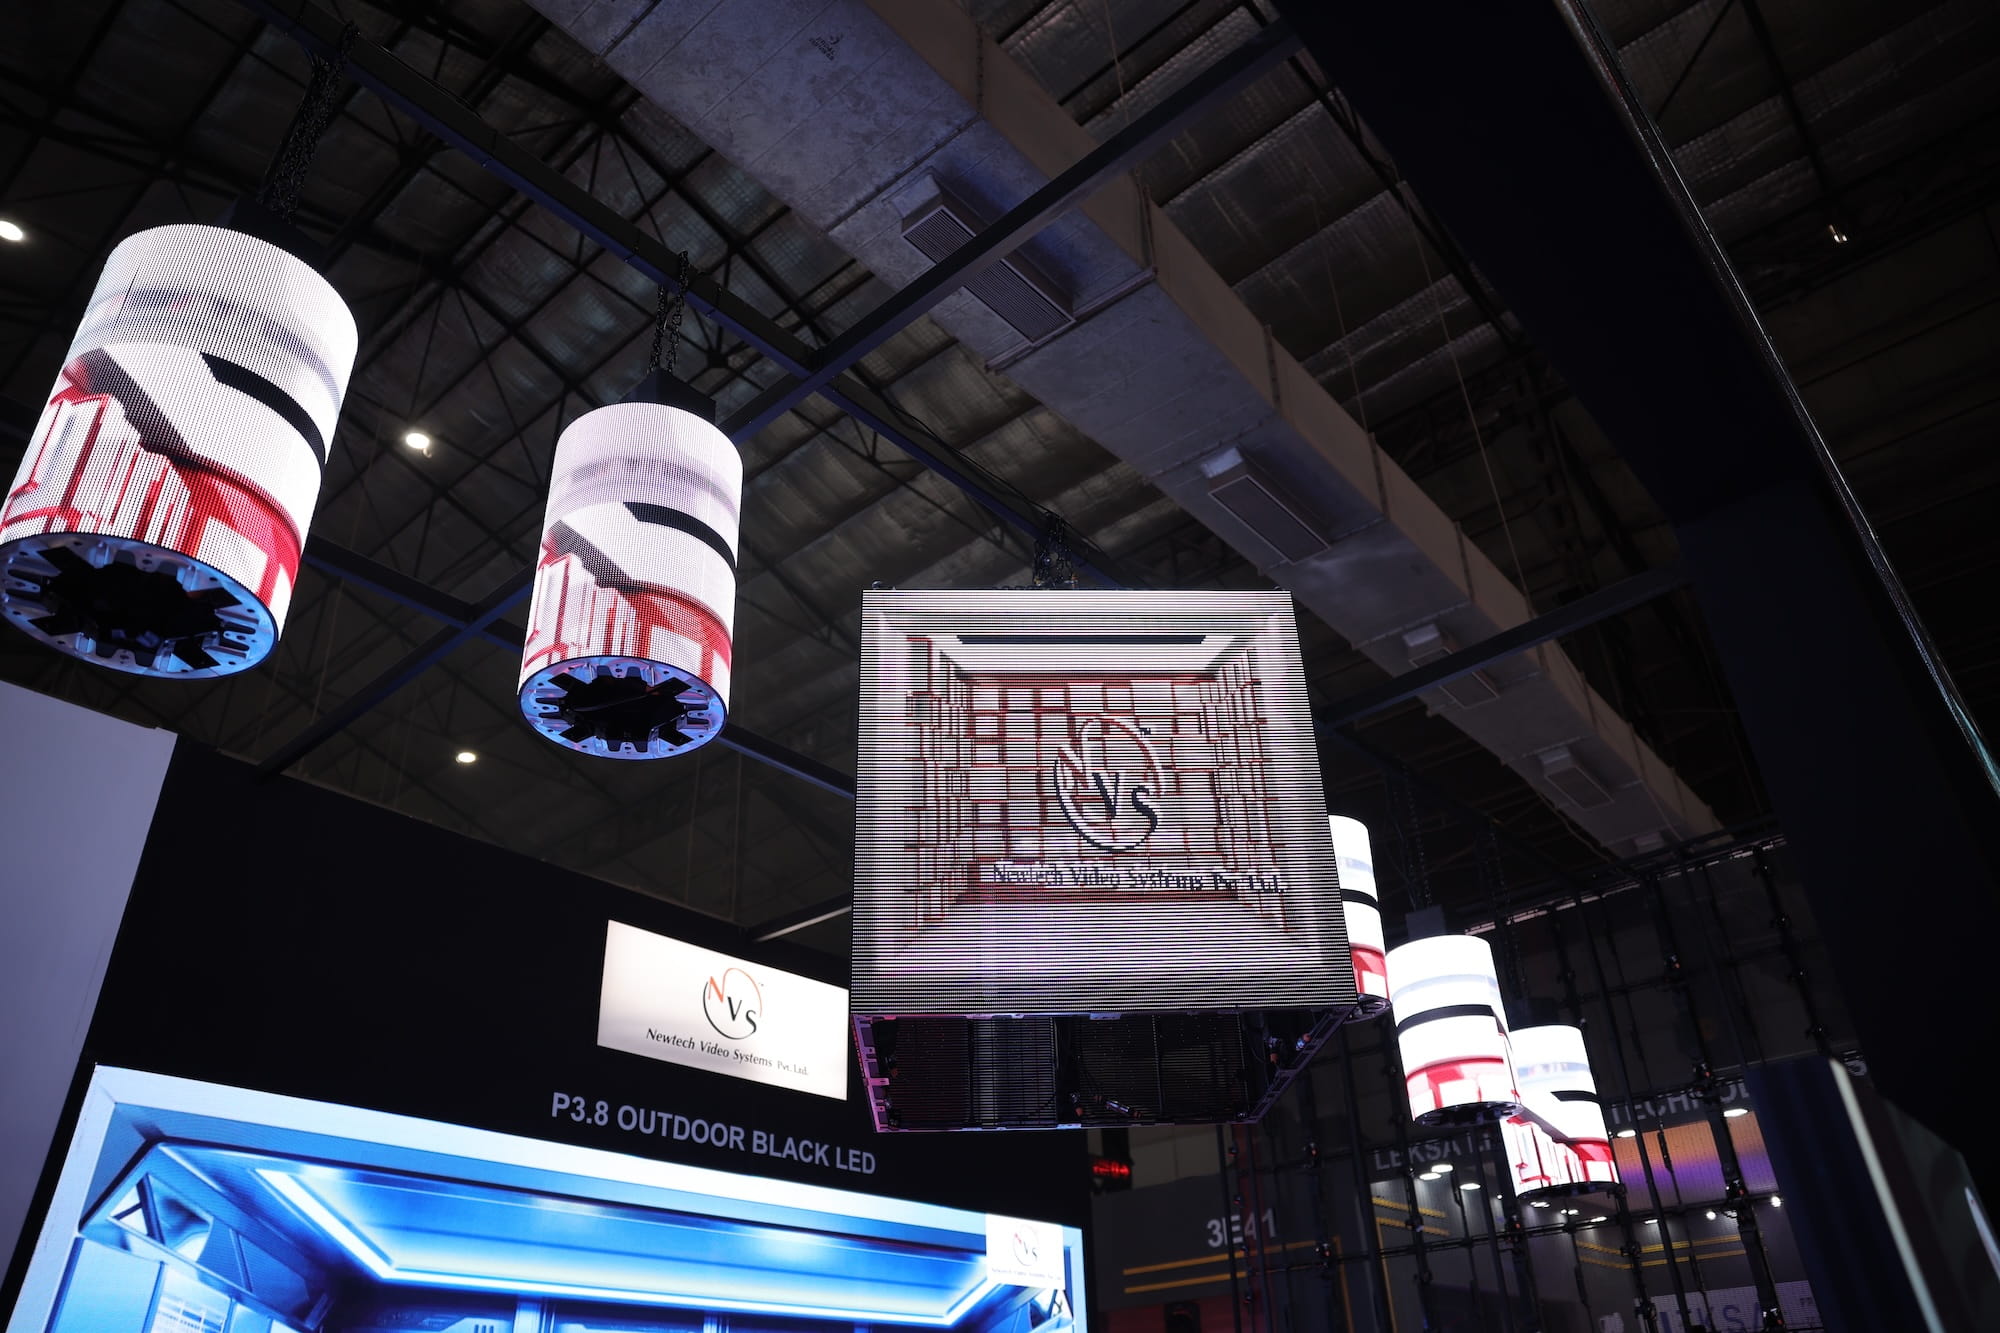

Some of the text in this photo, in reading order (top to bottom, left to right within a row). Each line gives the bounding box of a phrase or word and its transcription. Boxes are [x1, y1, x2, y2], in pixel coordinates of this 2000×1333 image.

[993, 863, 1063, 887] Newtech
[1069, 866, 1120, 889] Video
[1127, 868, 1204, 893] Systems
[706, 974, 758, 1035] NVS
[646, 1028, 696, 1051] Newtech
[700, 1040, 730, 1058] Video
[733, 1048, 773, 1066] Systems
[552, 1092, 876, 1175] P3.8 OUTDOOR BLACK LED
[1206, 1207, 1277, 1249] 3E41
